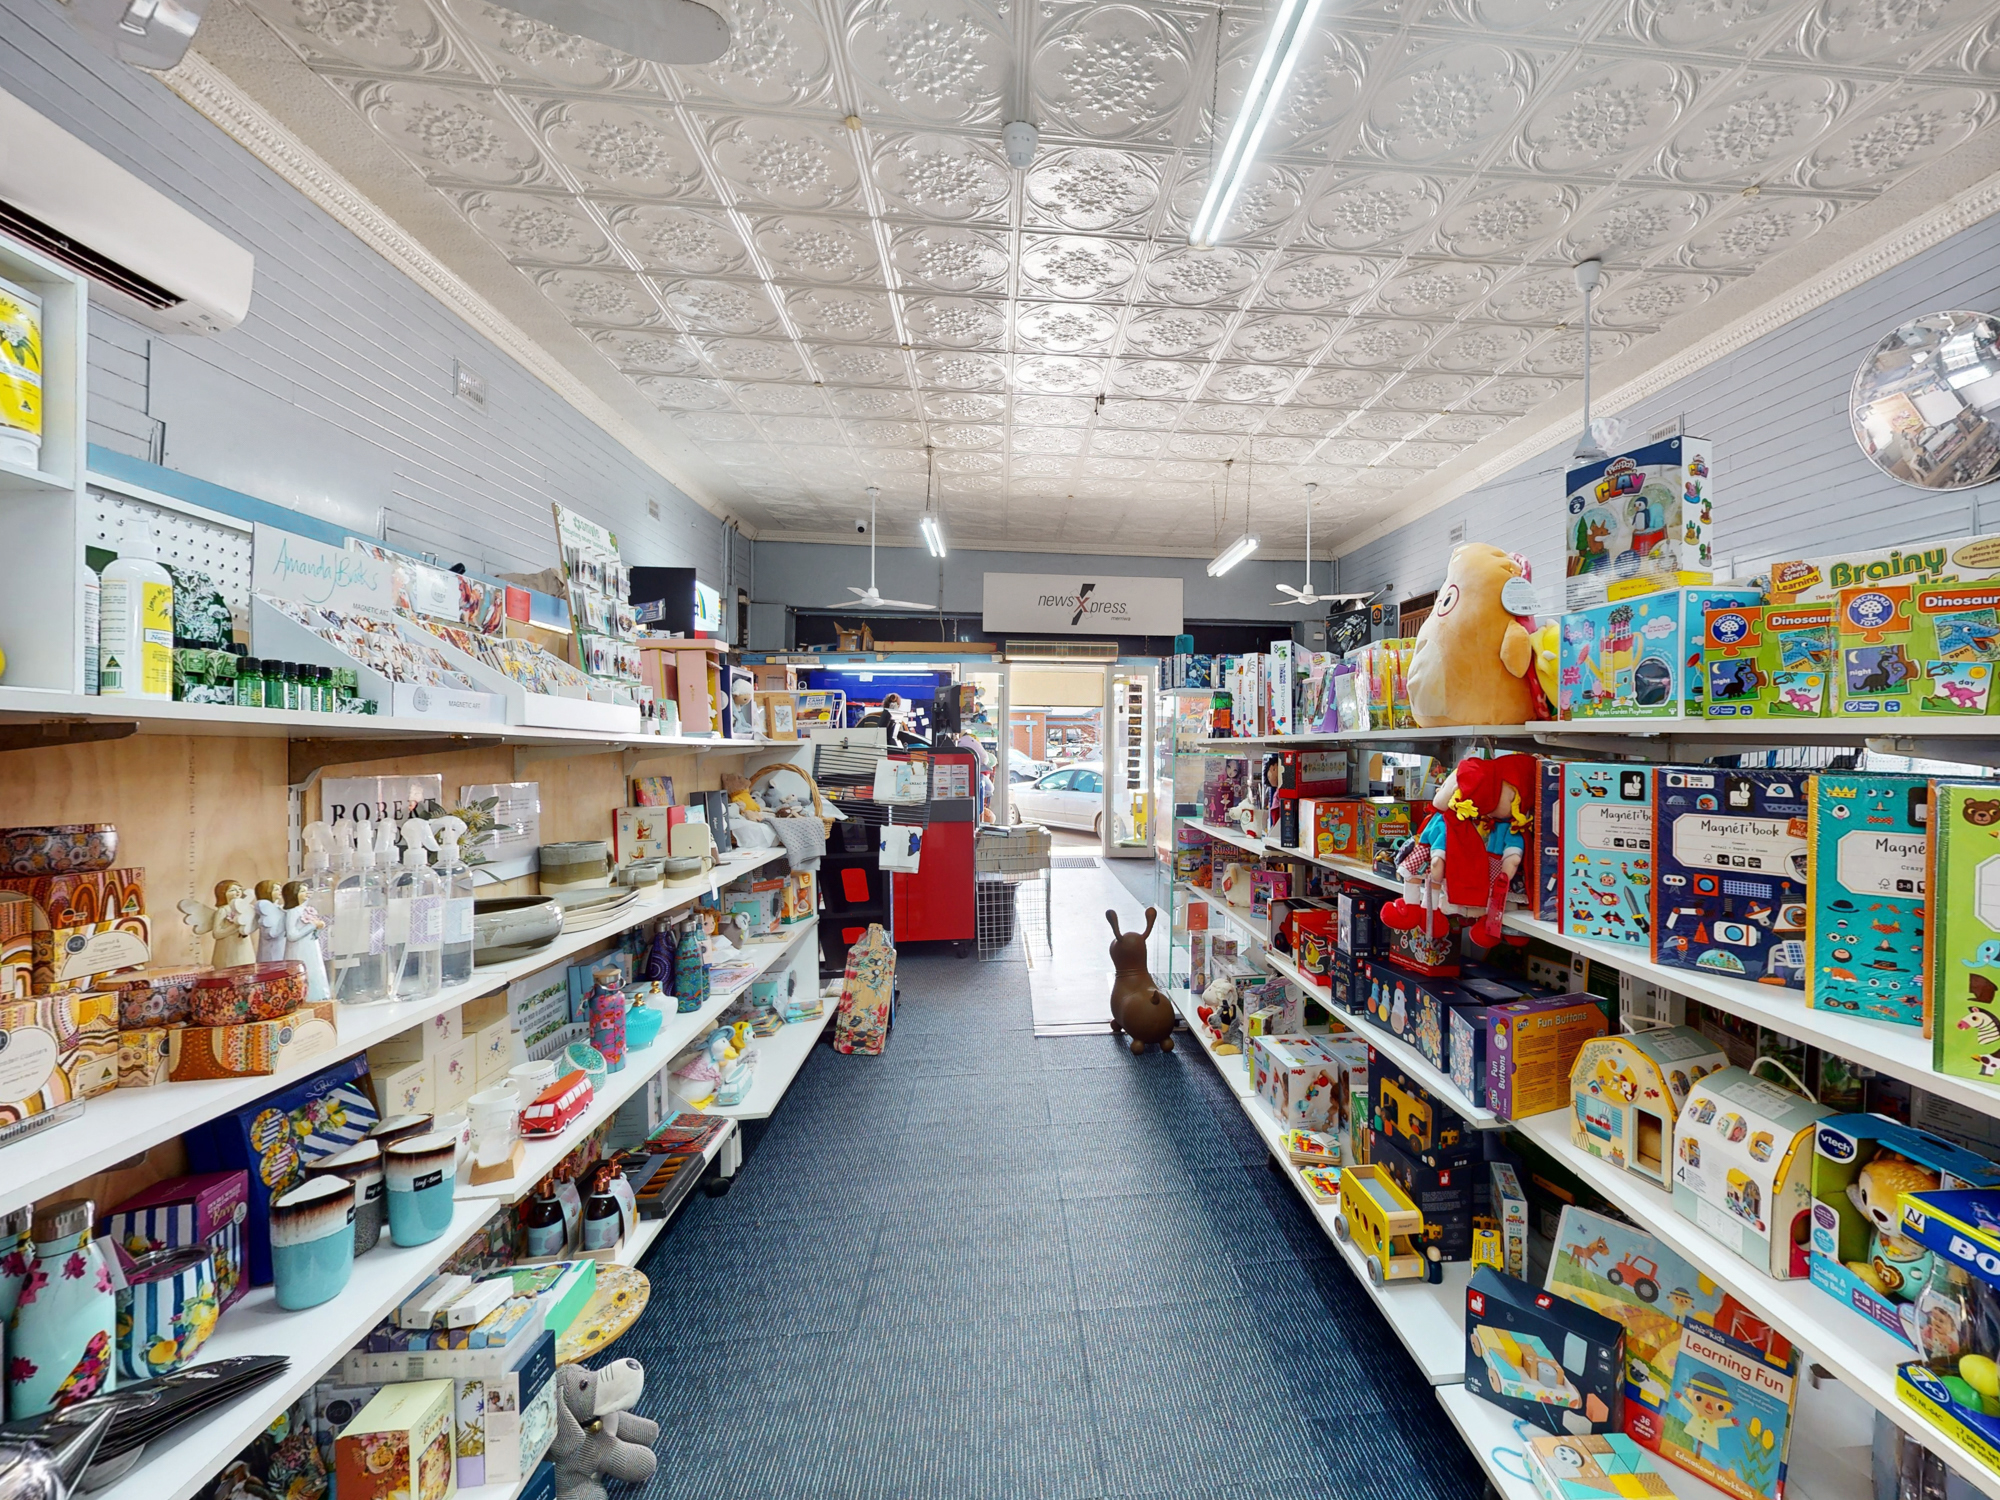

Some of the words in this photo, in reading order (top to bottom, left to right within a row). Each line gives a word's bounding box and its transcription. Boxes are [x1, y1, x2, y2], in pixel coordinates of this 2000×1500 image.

[1606, 460, 1634, 475] Play-Doh
[1688, 463, 1708, 478] CLAY
[1594, 472, 1646, 504] CLAY
[1573, 503, 1581, 512] 2
[273, 538, 332, 582] Amanda
[1784, 563, 1808, 575] Small
[1784, 570, 1808, 582] World
[1830, 548, 1947, 589] Brainy
[1776, 576, 1820, 592] Learning
[146, 595, 158, 612] Lemon
[1038, 594, 1128, 614] newsXpress
[1852, 594, 1890, 608] ORCHARD
[352, 602, 378, 616] MAGNETIC
[378, 608, 389, 617] ART
[1715, 615, 1744, 627] ORCHARD
[1772, 615, 1832, 626] Dinosaur
[1583, 620, 1594, 639] Pig
[1948, 648, 1970, 660] open
[1790, 660, 1807, 670] open
[1850, 668, 1872, 676] night
[448, 700, 472, 708] MAGNETIC
[1628, 707, 1653, 716] Playhouse
[331, 798, 436, 826] ROBERT
[1701, 820, 1780, 837] Magnéti'book
[1537, 1018, 1552, 1028] Fun
[1555, 1012, 1587, 1024] Buttons
[1821, 1133, 1850, 1152] vtech
[1677, 1166, 1686, 1182] 4
[1905, 1208, 1923, 1226] N
[1950, 1236, 2000, 1277] BO
[1813, 1262, 1839, 1284] Cuddle
[1840, 1277, 1847, 1289] &
[1813, 1271, 1829, 1289] Sing
[1830, 1280, 1847, 1298] Bear
[1853, 1292, 1870, 1308] 3-18
[1708, 1329, 1725, 1344] kids
[1685, 1334, 1751, 1381] Learning
[1755, 1368, 1784, 1394] Fun
[1633, 1420, 1654, 1435] magnetic
[1639, 1415, 1651, 1426] 36
[1634, 1426, 1651, 1438] pieces
[1962, 1436, 1975, 1450] ball
[1675, 1450, 1716, 1479] Educational
[1716, 1473, 1754, 1498] Workbook
